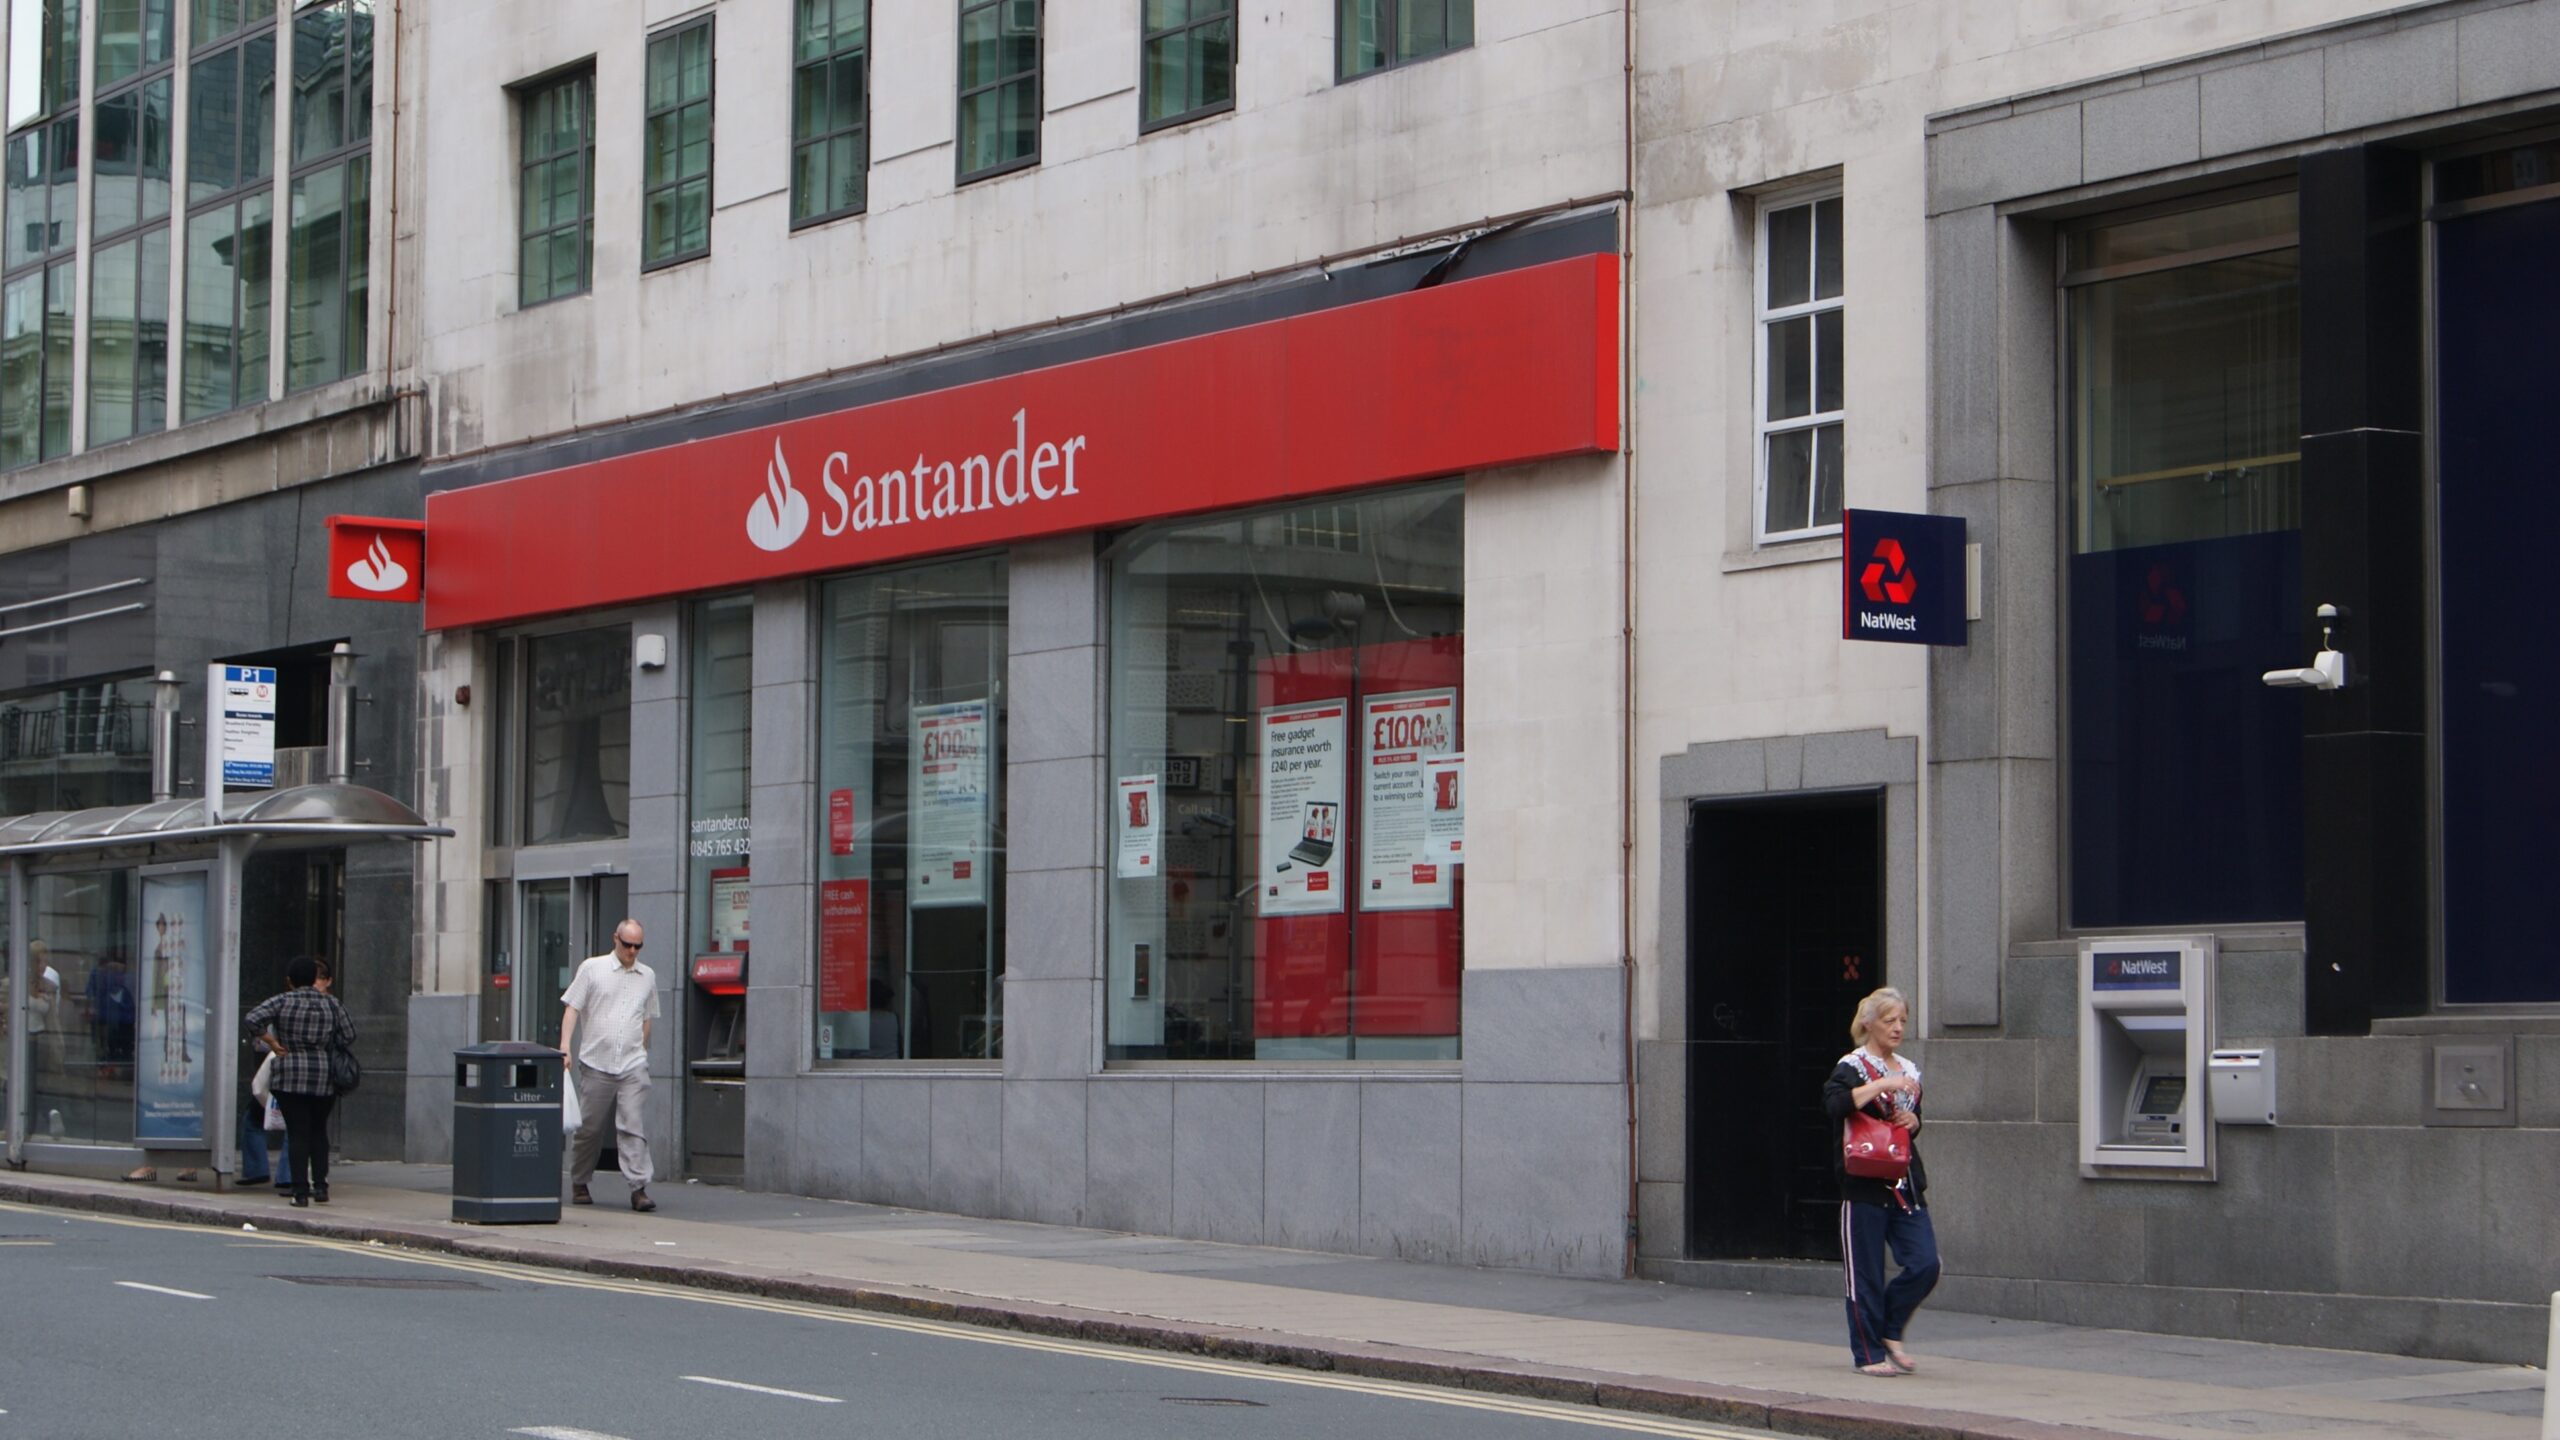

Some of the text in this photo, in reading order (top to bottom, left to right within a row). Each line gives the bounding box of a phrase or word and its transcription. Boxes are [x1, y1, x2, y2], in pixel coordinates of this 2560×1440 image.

[822, 407, 1086, 537] Santander
[1861, 611, 1916, 631] NatWest
[241, 669, 260, 682] P1
[1271, 728, 1315, 743] Free gadget
[1373, 714, 1425, 751] £100
[1271, 740, 1332, 757] insurance worth
[1271, 760, 1288, 773] £240
[1289, 760, 1302, 774] per
[690, 840, 713, 857] 0845
[715, 839, 732, 856] 765
[2121, 959, 2168, 974] NatWest
[513, 1092, 541, 1102] Litter
